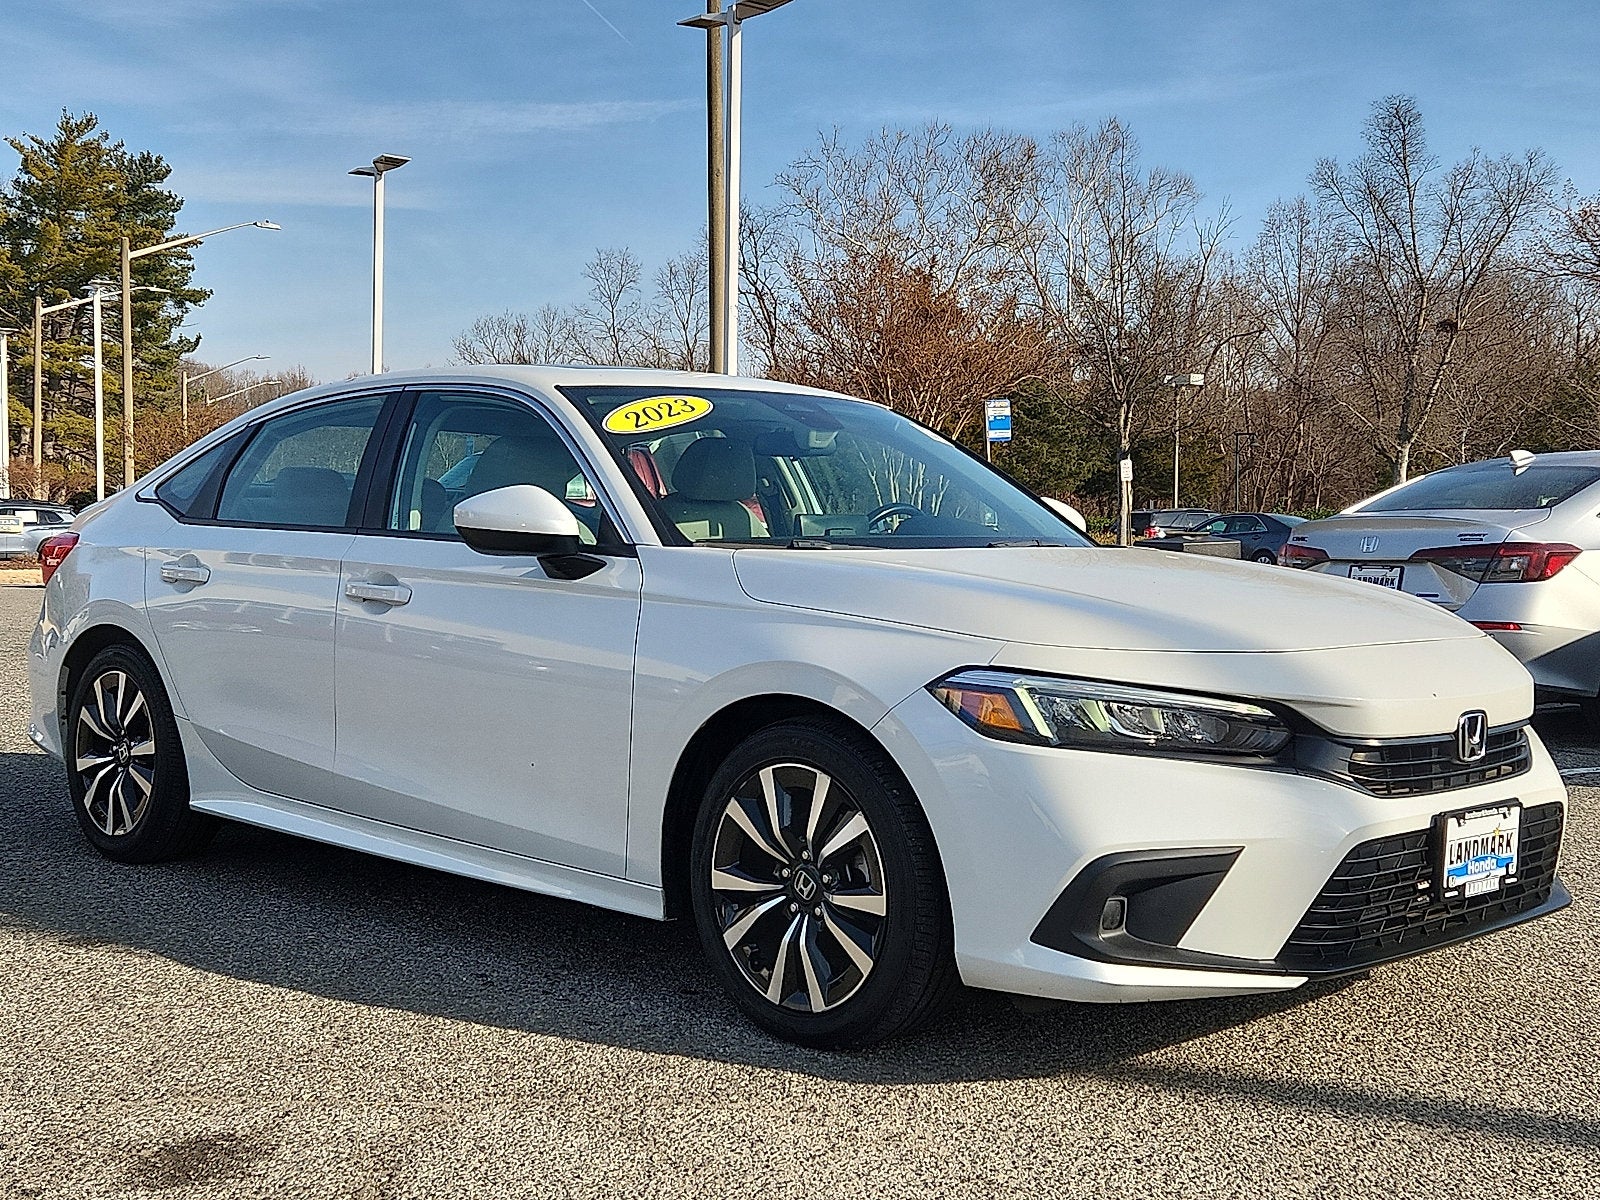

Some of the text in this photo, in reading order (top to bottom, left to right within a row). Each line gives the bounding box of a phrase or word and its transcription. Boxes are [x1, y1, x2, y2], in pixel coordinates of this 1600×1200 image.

[624, 398, 696, 429] 2023
[1448, 831, 1514, 866] LANDMARK
[1468, 857, 1498, 876] Honda
